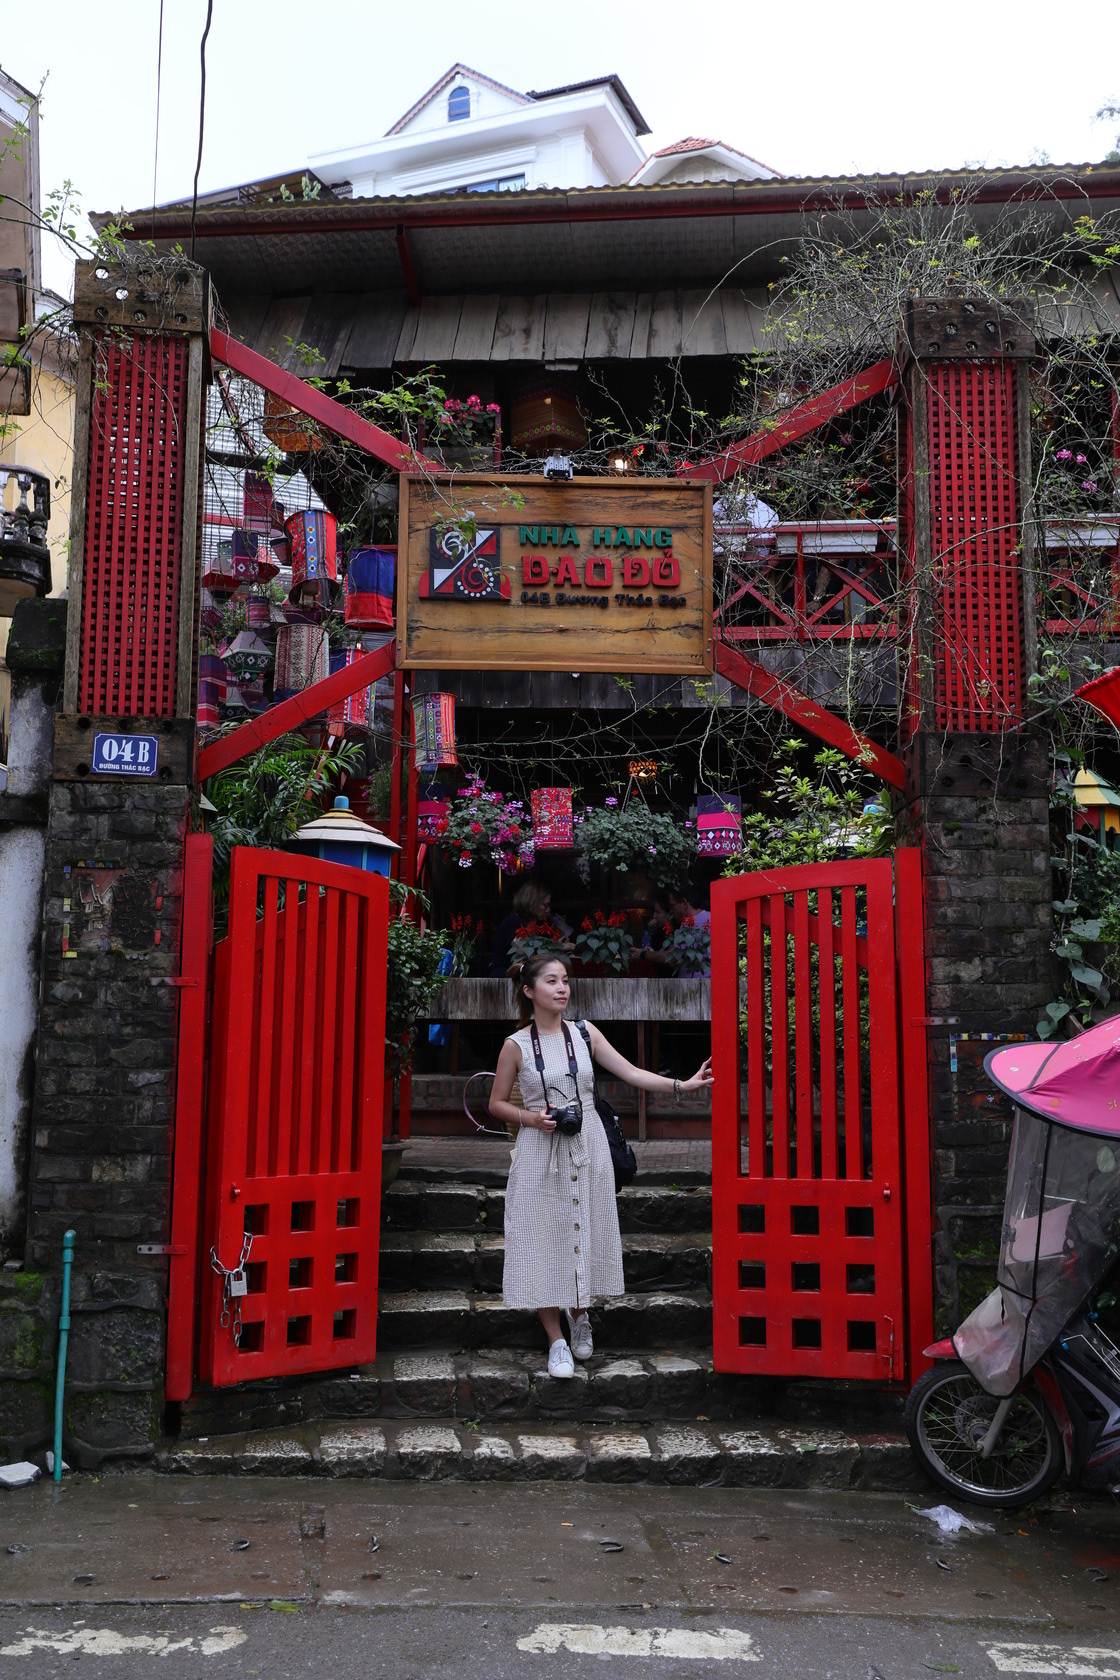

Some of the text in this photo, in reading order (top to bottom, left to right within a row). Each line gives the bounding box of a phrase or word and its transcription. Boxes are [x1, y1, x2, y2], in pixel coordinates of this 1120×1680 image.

[520, 522, 673, 548] NHÀ HÀNG
[521, 548, 681, 588] DAO ĐỎ
[521, 591, 551, 604] 04B
[615, 593, 653, 606] Thác
